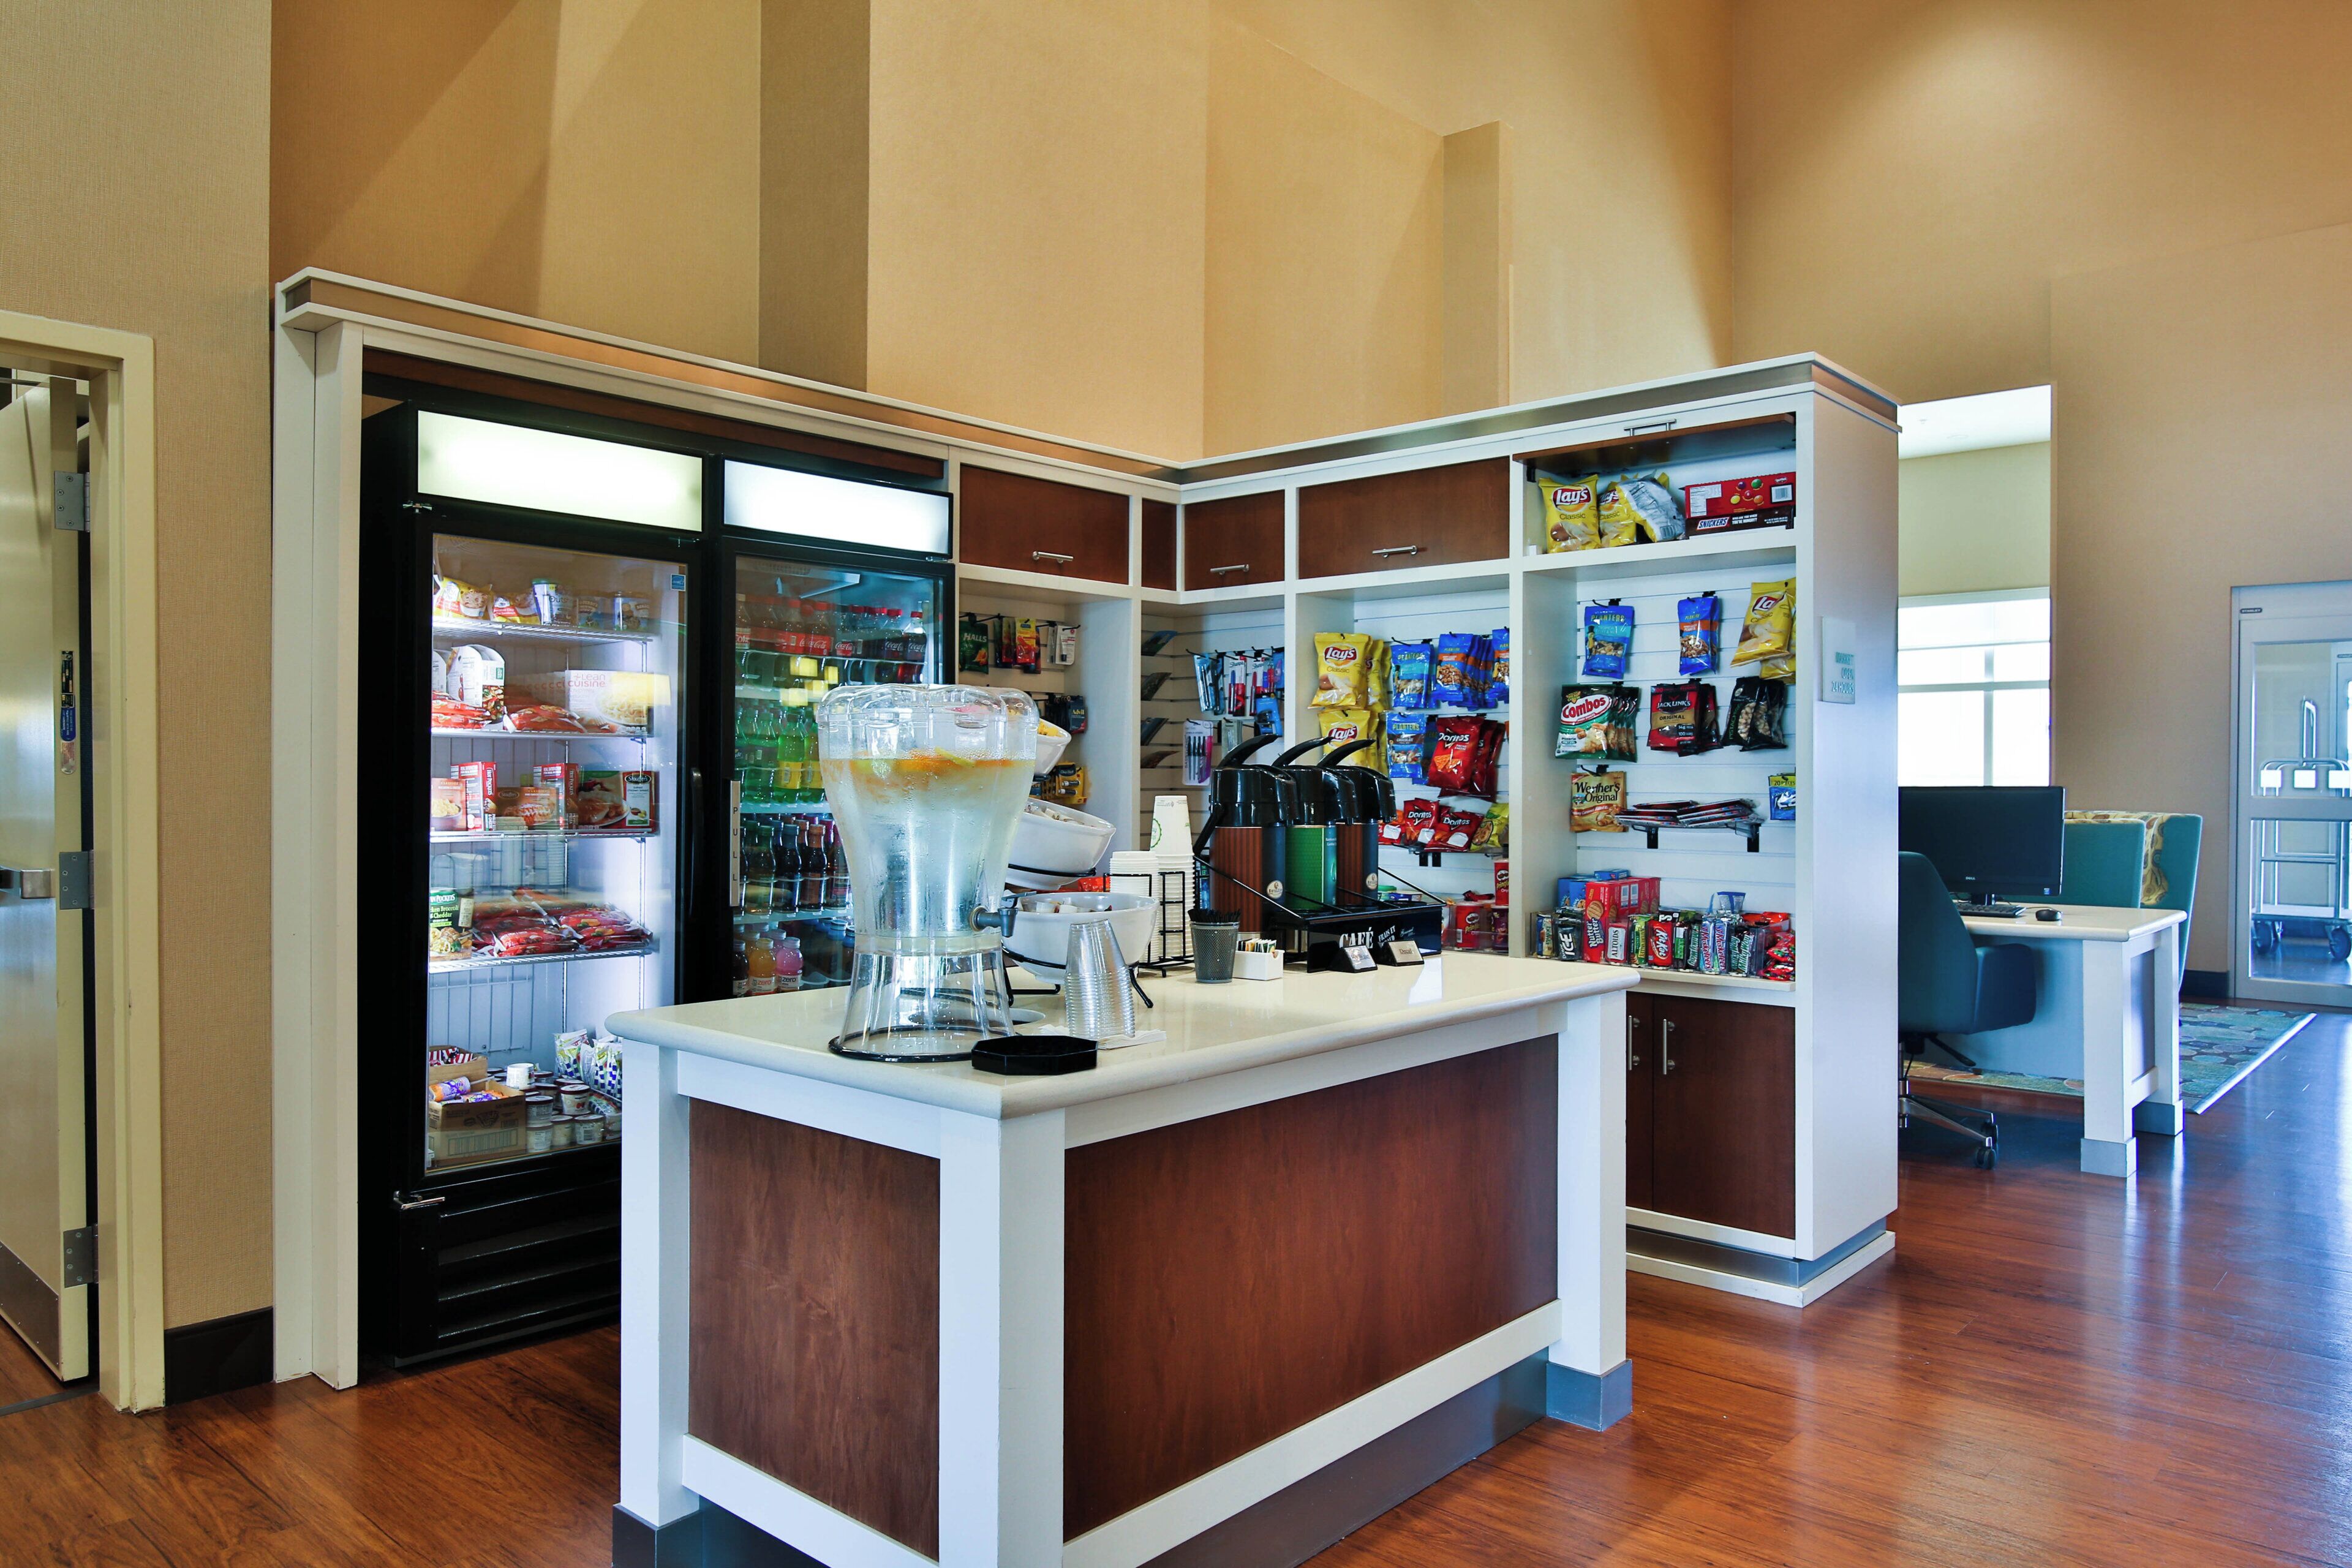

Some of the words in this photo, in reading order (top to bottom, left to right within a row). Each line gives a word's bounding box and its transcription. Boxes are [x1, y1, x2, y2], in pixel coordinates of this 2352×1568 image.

[1698, 518, 1728, 529] SNICKERS
[963, 633, 987, 643] HALLS
[1841, 667, 1855, 680] OPEN
[1832, 680, 1838, 692] 24
[1838, 682, 1855, 694] HOURS
[1562, 696, 1606, 718] Combos
[1439, 733, 1470, 743] Doritos
[1574, 782, 1620, 794] Werther's
[1585, 791, 1618, 804] Original
[1442, 816, 1471, 825] Doritos
[436, 894, 456, 903] POCKETS
[1339, 927, 1374, 949] CAFÉ
[1378, 929, 1390, 942] FRAIS
[1390, 925, 1396, 934] ET
[1586, 921, 1599, 948] Nutter
[1591, 918, 1604, 944] Butter
[1559, 932, 1575, 956] ICE
[1701, 932, 1712, 969] Musketeers
[1741, 935, 1754, 951] Way
[1716, 932, 1726, 971] Musketeers
[1738, 948, 1751, 973] Milky
